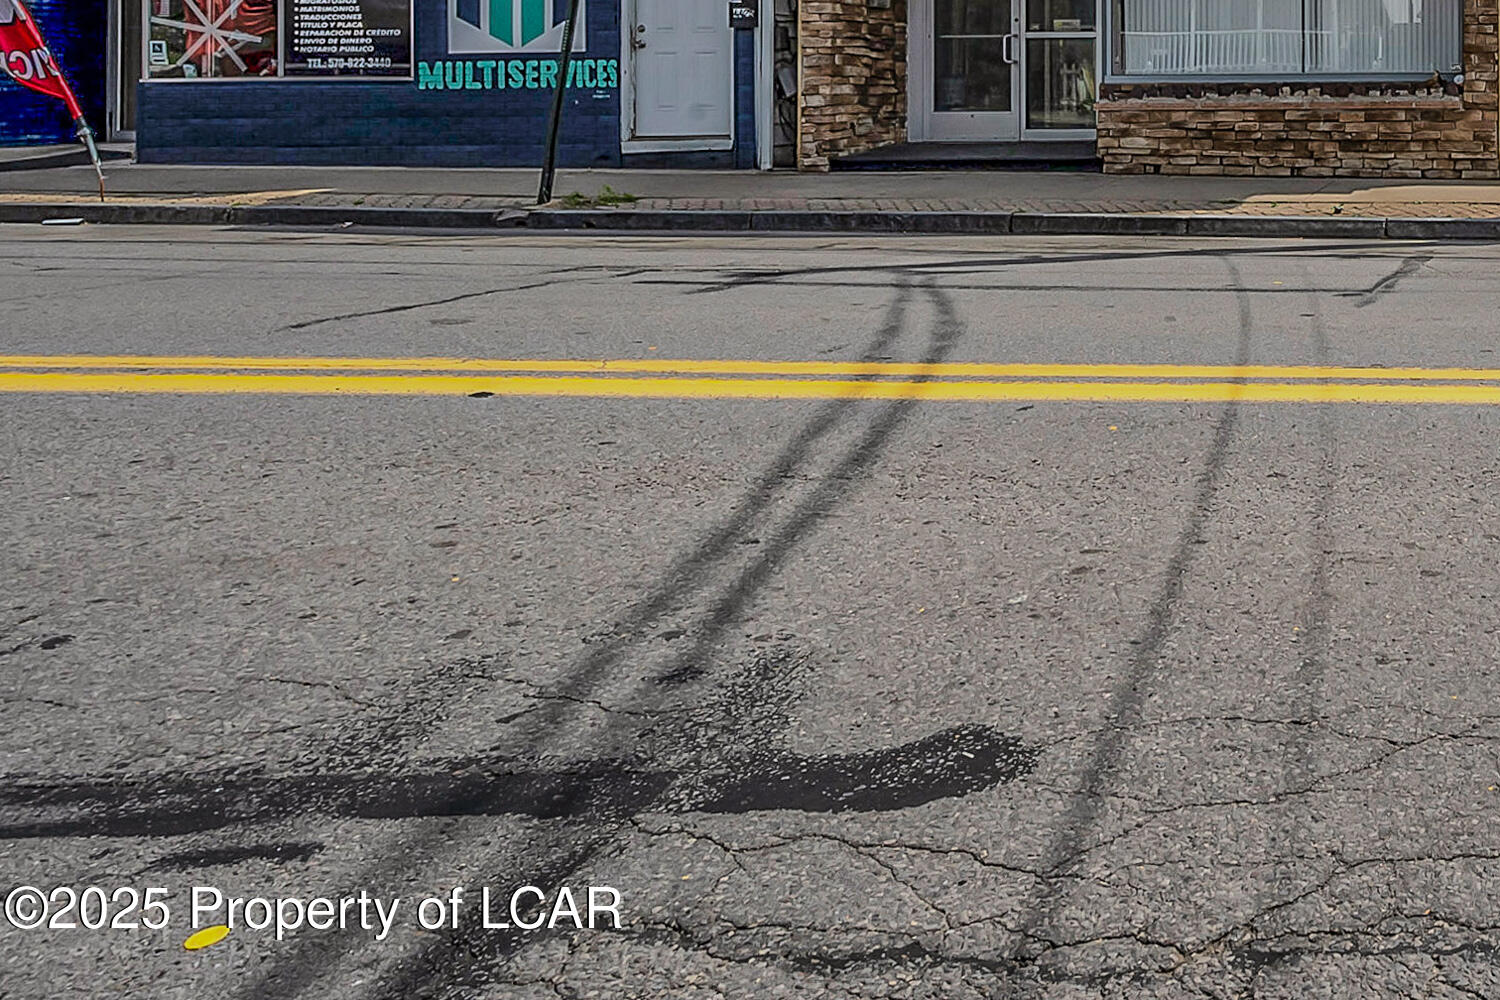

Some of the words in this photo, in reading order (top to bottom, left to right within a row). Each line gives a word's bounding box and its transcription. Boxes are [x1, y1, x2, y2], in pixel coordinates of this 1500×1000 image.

[300, 5, 360, 13] MATRIMONIOS
[300, 13, 362, 21] TRADUCCIONES
[328, 37, 338, 45] DE
[300, 45, 337, 53] NOTARIO
[328, 58, 392, 68] 570-822-3440
